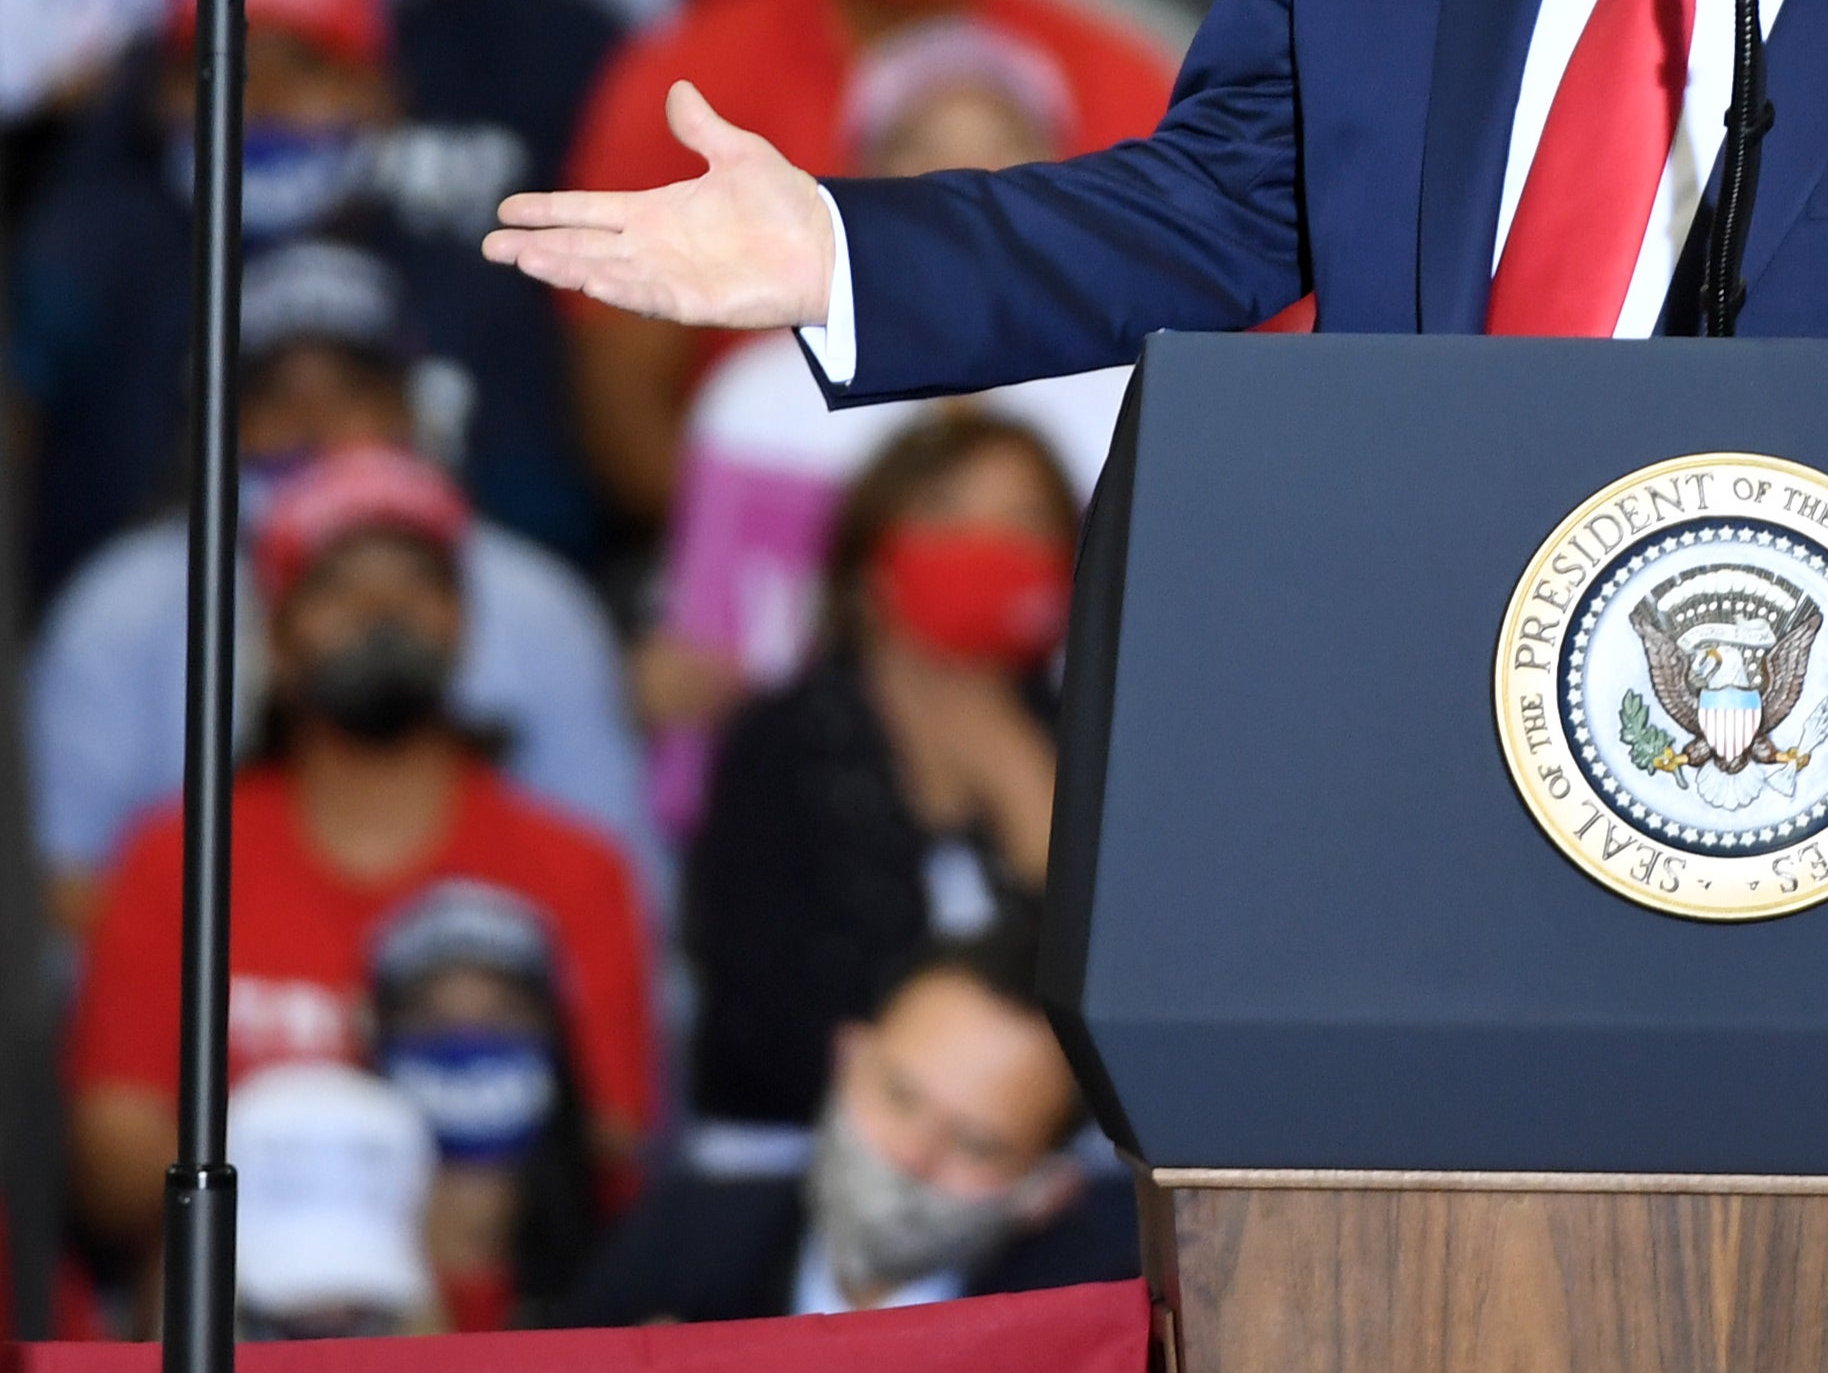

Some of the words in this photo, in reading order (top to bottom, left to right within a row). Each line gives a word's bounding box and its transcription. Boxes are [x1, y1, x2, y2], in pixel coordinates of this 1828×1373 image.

[1732, 477, 1772, 504] OF
[1514, 472, 1715, 675] PRESIDENT
[1520, 692, 1554, 755] THE
[1537, 762, 1571, 800] OF
[1574, 799, 1687, 894] SEAL
